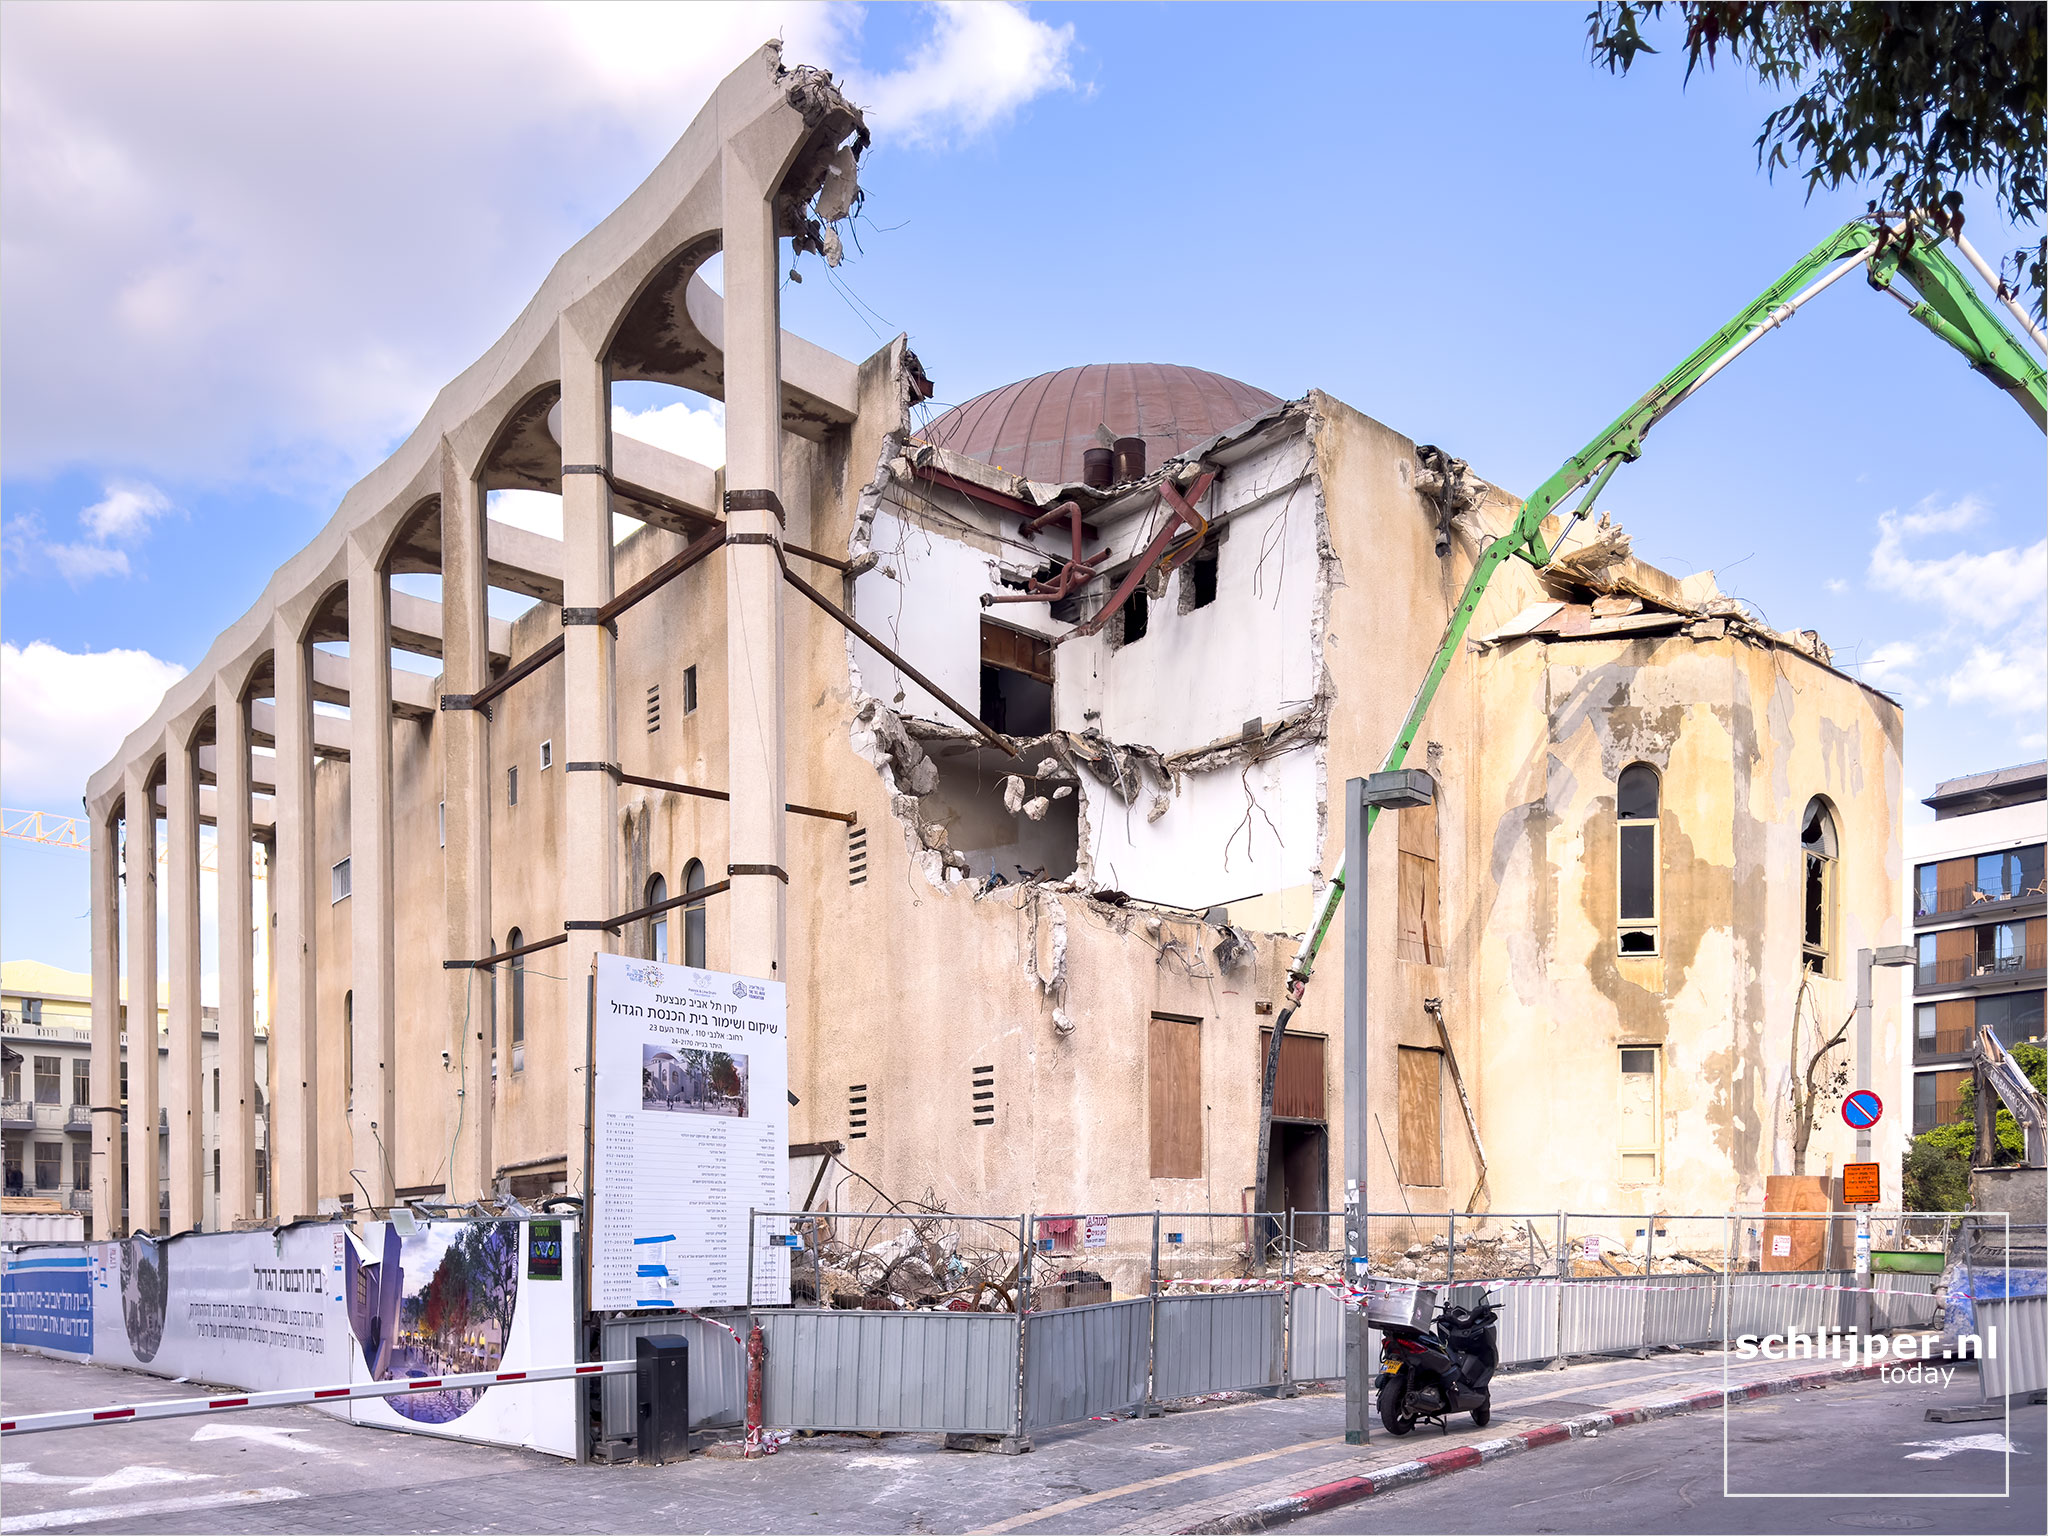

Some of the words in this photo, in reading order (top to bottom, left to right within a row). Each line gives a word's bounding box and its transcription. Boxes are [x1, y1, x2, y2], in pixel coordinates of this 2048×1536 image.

[655, 994, 687, 1006] מבצעת
[688, 998, 708, 1009] אביב
[710, 1000, 722, 1012] תל
[610, 1000, 644, 1017] הגדול
[647, 1006, 686, 1022] הכנסת
[724, 1004, 738, 1015] קרן
[689, 1014, 709, 1026] בית
[712, 1015, 745, 1030] ושימור
[649, 1024, 658, 1032] 23
[660, 1025, 675, 1034] העם
[676, 1027, 690, 1036] אחד
[695, 1029, 706, 1038] 110
[748, 1021, 778, 1035] שיקום
[706, 1030, 725, 1040] אלנבי
[726, 1033, 744, 1042] רחוב:
[708, 1042, 722, 1050] היתר
[254, 1264, 278, 1291] הגדול
[280, 1268, 305, 1292] הכנסת
[306, 1268, 323, 1293] בית
